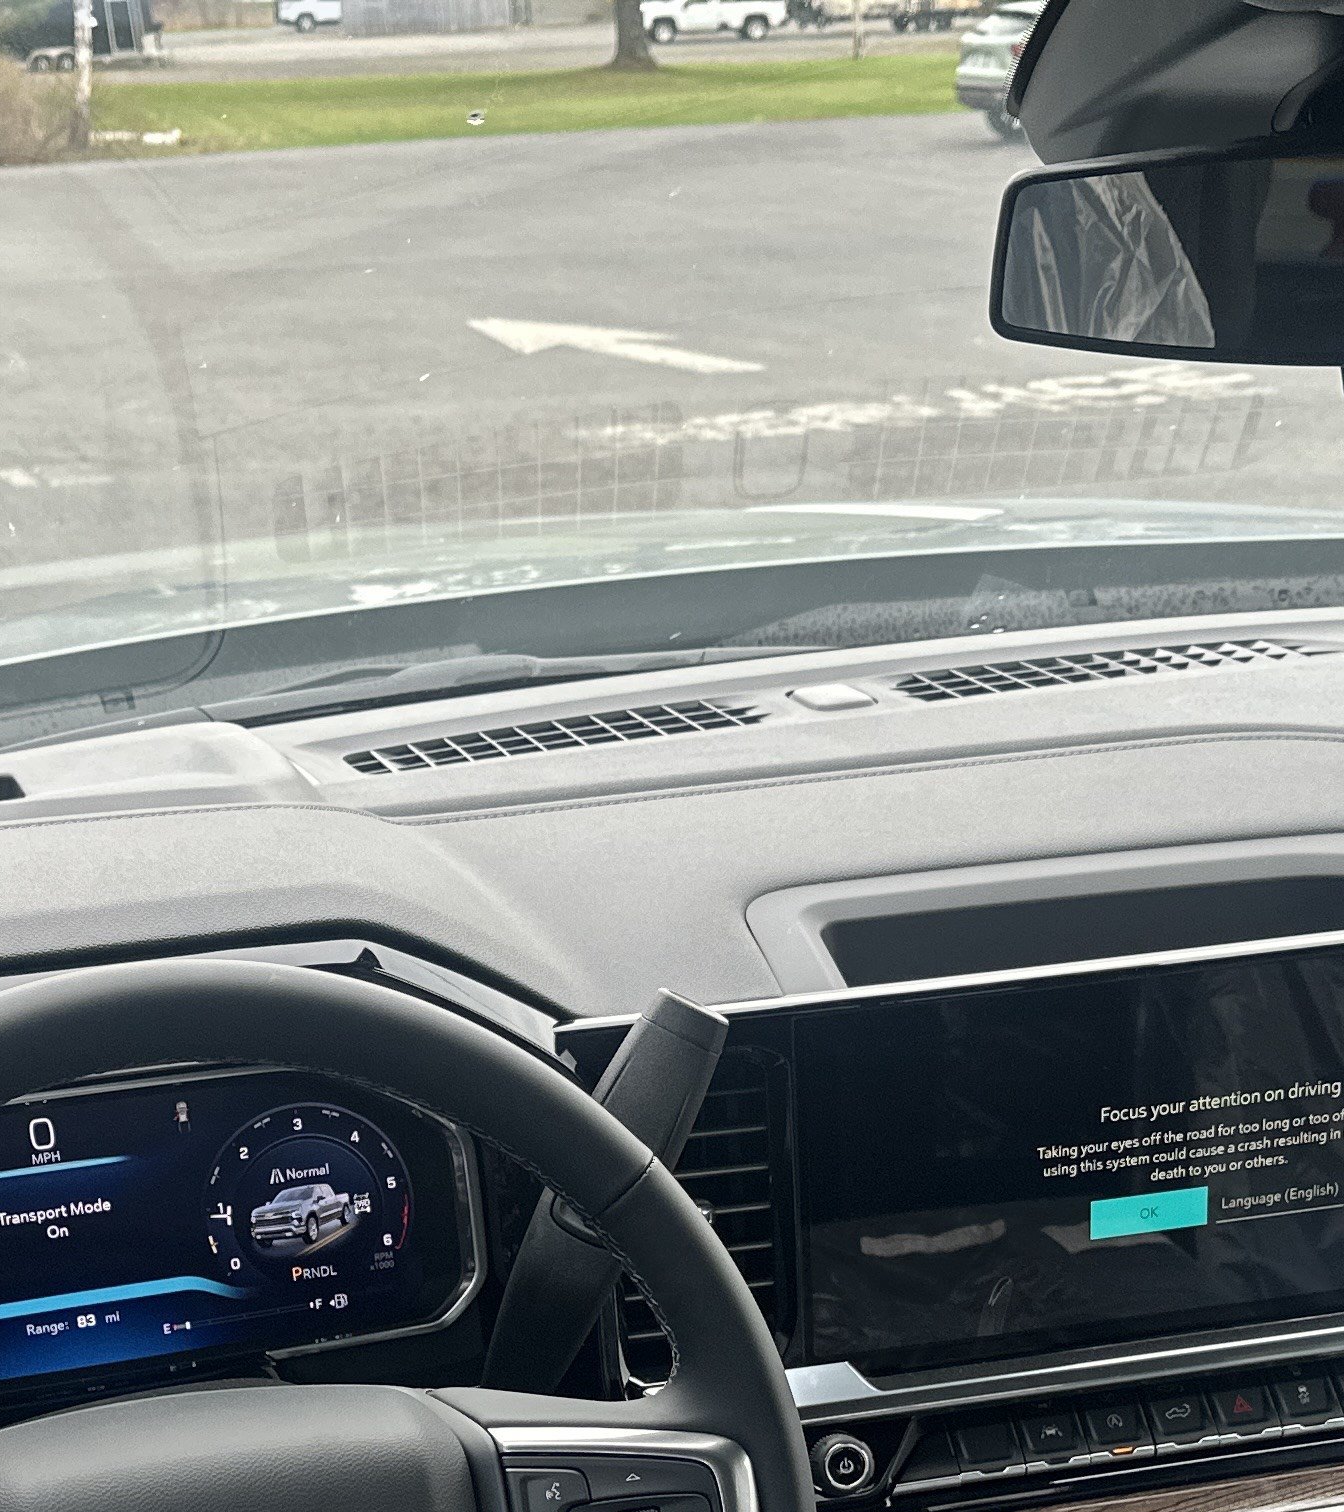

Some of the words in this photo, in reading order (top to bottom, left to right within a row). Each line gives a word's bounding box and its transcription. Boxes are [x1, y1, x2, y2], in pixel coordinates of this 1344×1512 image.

[1100, 1106, 1147, 1123] Focus
[1150, 1101, 1186, 1121] your
[1189, 1091, 1261, 1112] attention
[1264, 1088, 1284, 1102] on
[1288, 1080, 1342, 1098] driving
[293, 1118, 303, 1131] 3
[29, 1117, 55, 1150] 0
[350, 1130, 360, 1143] 4
[1036, 1145, 1077, 1160] Taking
[1080, 1141, 1108, 1158] your
[1111, 1137, 1139, 1153] eyes
[1142, 1132, 1162, 1147] off
[1163, 1131, 1183, 1143] the
[1187, 1125, 1215, 1140] road
[1218, 1124, 1236, 1136] for
[1238, 1122, 1259, 1134] too
[1262, 1118, 1289, 1132] long
[1292, 1116, 1307, 1126] or
[1308, 1113, 1330, 1125] too
[31, 1150, 61, 1165] MPH
[239, 1147, 249, 1160] 2
[1043, 1162, 1077, 1178] using
[1080, 1159, 1103, 1172] this
[1106, 1153, 1150, 1171] system
[1152, 1147, 1186, 1162] could
[1189, 1145, 1225, 1158] cause
[1227, 1144, 1235, 1153] a
[1237, 1137, 1271, 1152] crash
[1274, 1131, 1327, 1148] resulting
[1330, 1129, 1341, 1140] in
[286, 1163, 330, 1180] Normal
[1150, 1166, 1186, 1181] death
[1189, 1165, 1201, 1176] to
[1204, 1162, 1226, 1178] you
[1229, 1160, 1243, 1171] or
[1245, 1155, 1288, 1169] others.
[387, 1176, 397, 1189] 5
[69, 1198, 111, 1216] Mode
[1140, 1206, 1159, 1219] OK
[1221, 1192, 1282, 1210] Language
[1284, 1182, 1339, 1204] (English)
[47, 1225, 69, 1239] On
[383, 1234, 393, 1246] 6
[230, 1257, 241, 1270] 0
[315, 1298, 323, 1309] F
[26, 1321, 70, 1336] Range:
[105, 1310, 121, 1323] mi
[163, 1323, 171, 1335] E
